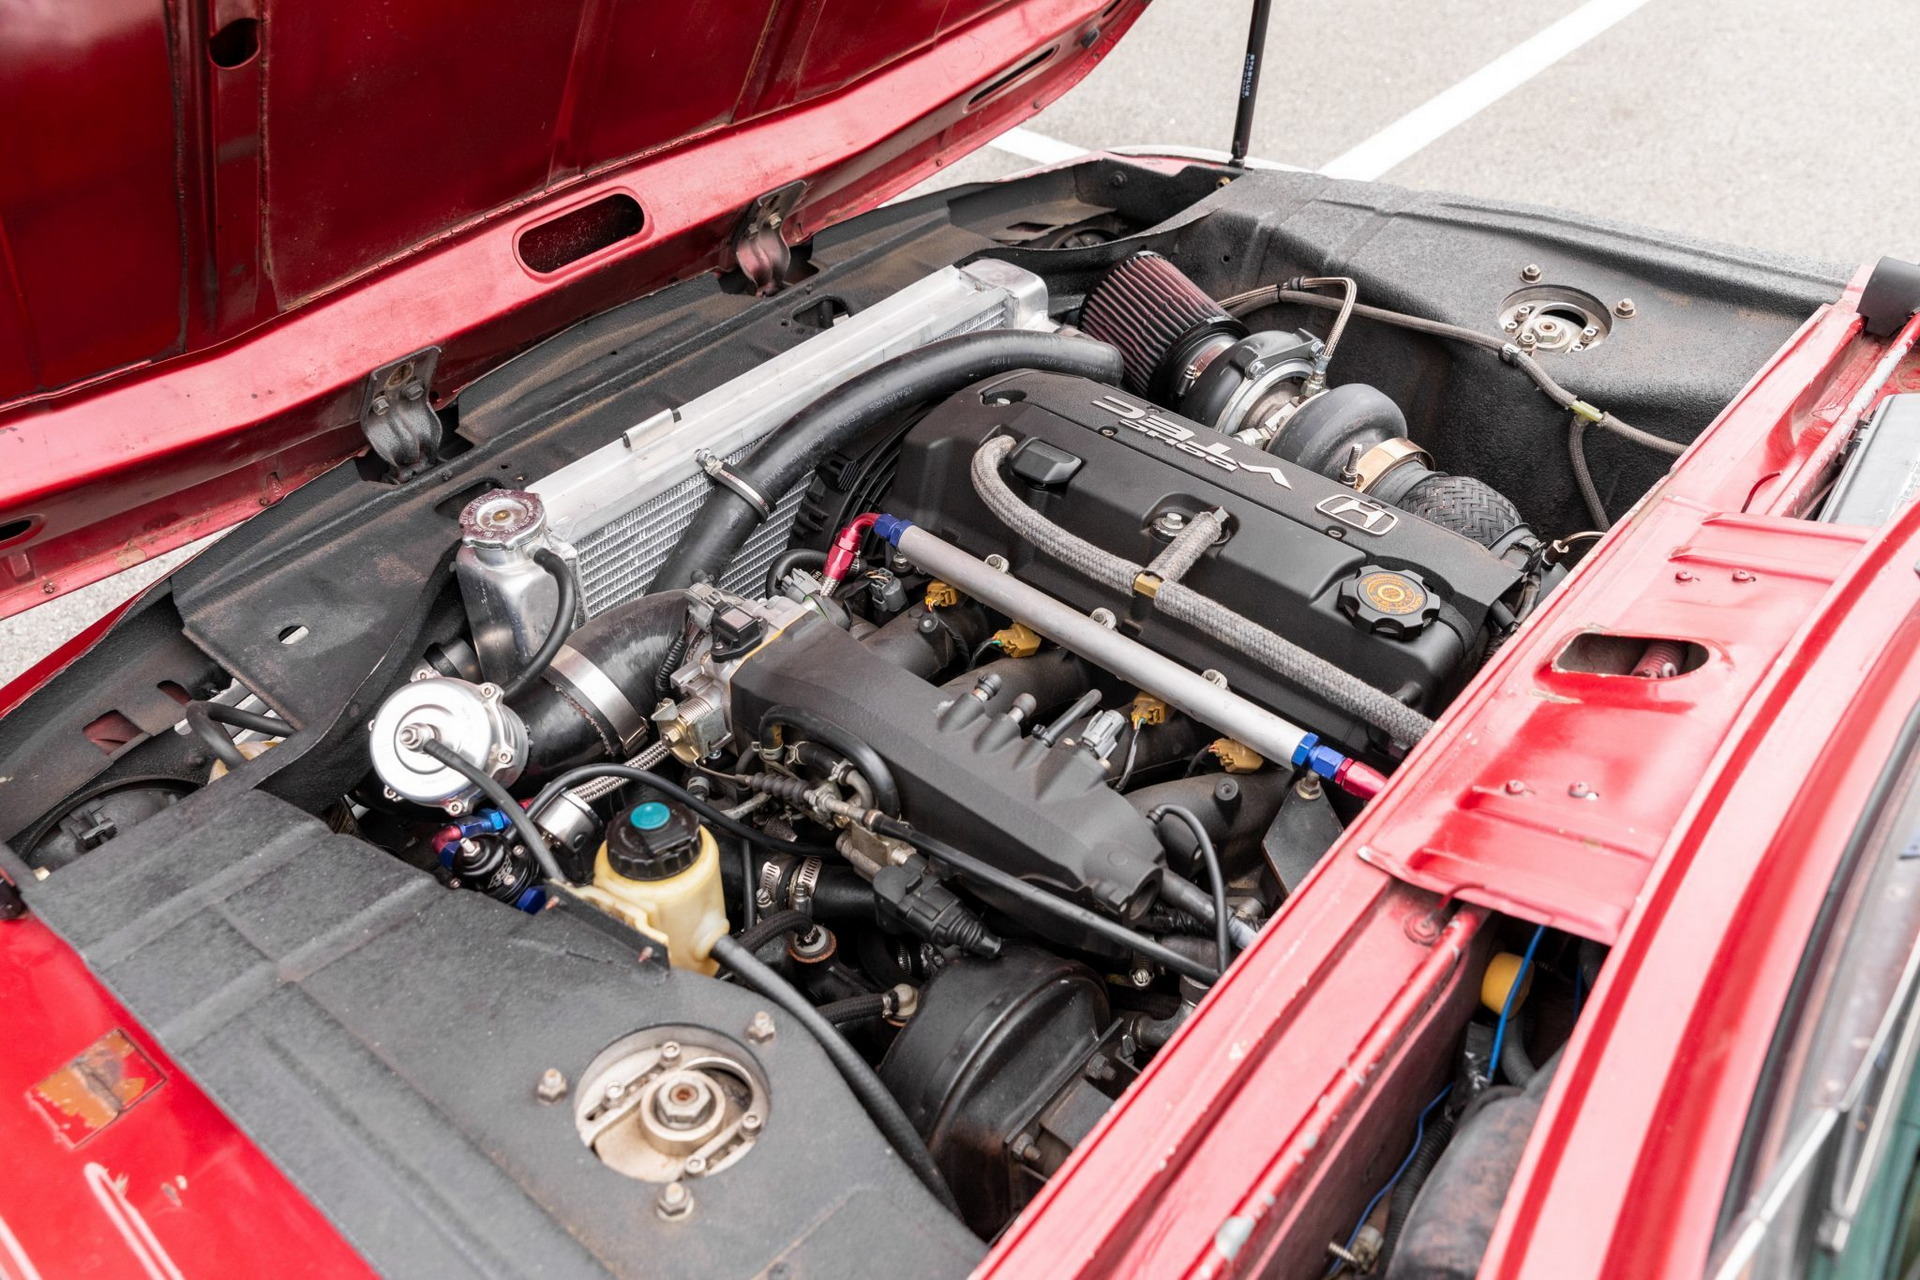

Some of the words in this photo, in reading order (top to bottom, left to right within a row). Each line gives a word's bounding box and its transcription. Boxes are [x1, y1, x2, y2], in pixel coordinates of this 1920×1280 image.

[1244, 54, 1255, 97] STABILUS
[1091, 396, 1293, 491] VTEC
[1118, 418, 1239, 473] DOHC
